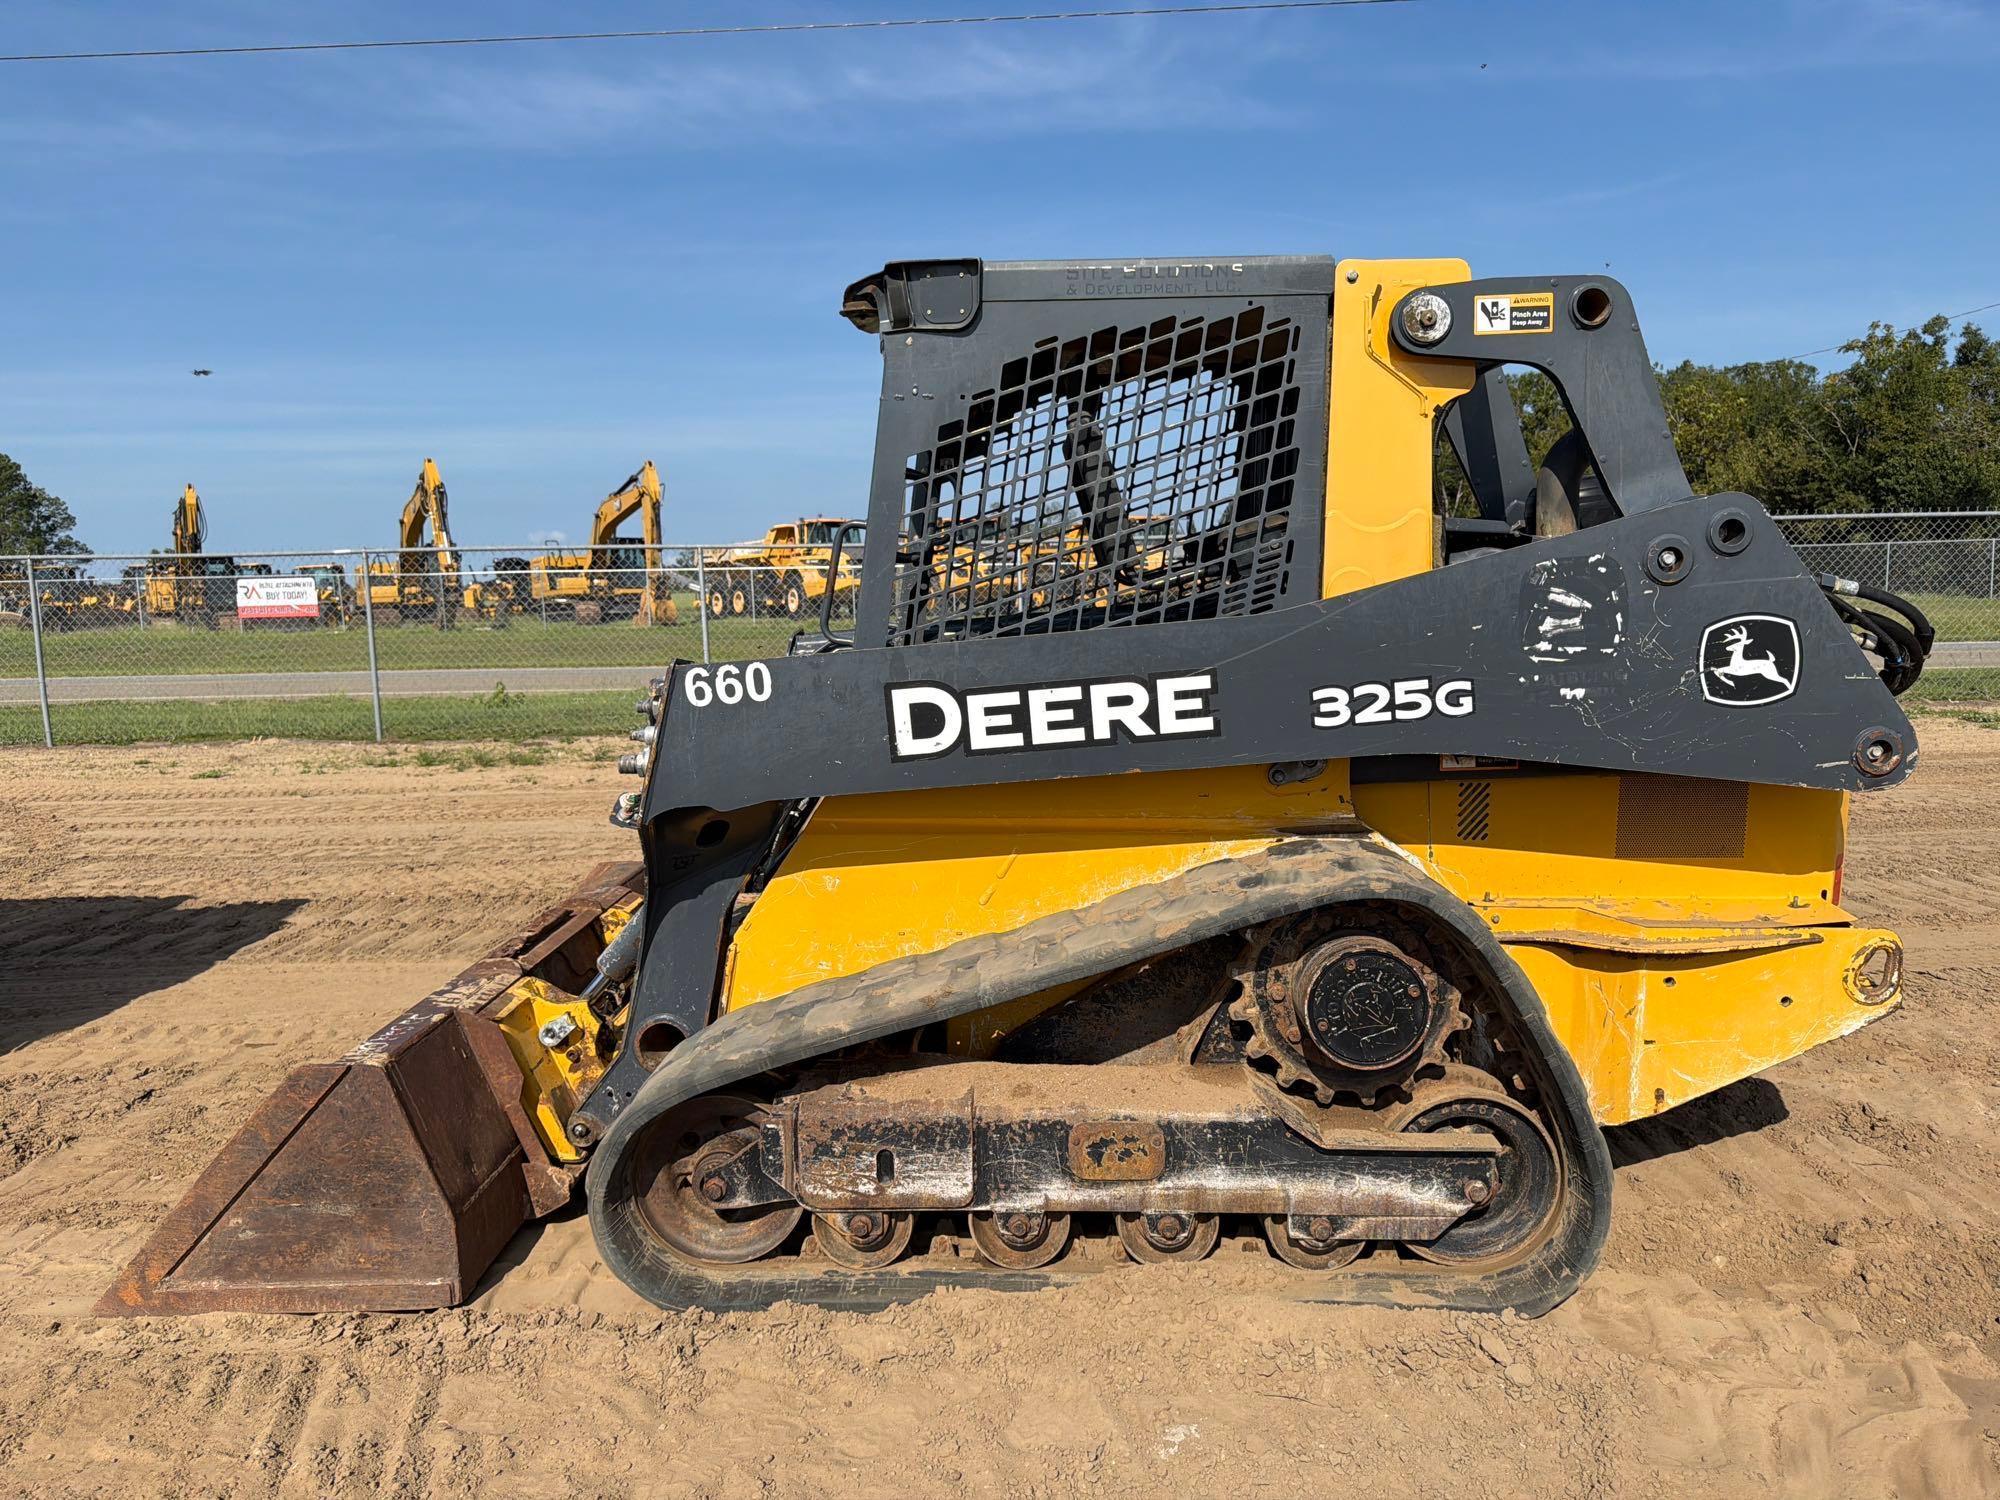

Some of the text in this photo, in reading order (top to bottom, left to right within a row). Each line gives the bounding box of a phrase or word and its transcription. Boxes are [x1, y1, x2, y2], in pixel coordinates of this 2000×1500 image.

[1066, 263, 1244, 281] SITE SOLUTIONS
[1066, 284, 1077, 296] &
[1520, 296, 1549, 304] WARNING
[1512, 319, 1527, 327] Keep
[265, 591, 281, 601] BUY
[684, 661, 772, 708] 660
[1312, 680, 1474, 728] 325G
[891, 674, 1214, 757] DEERE
